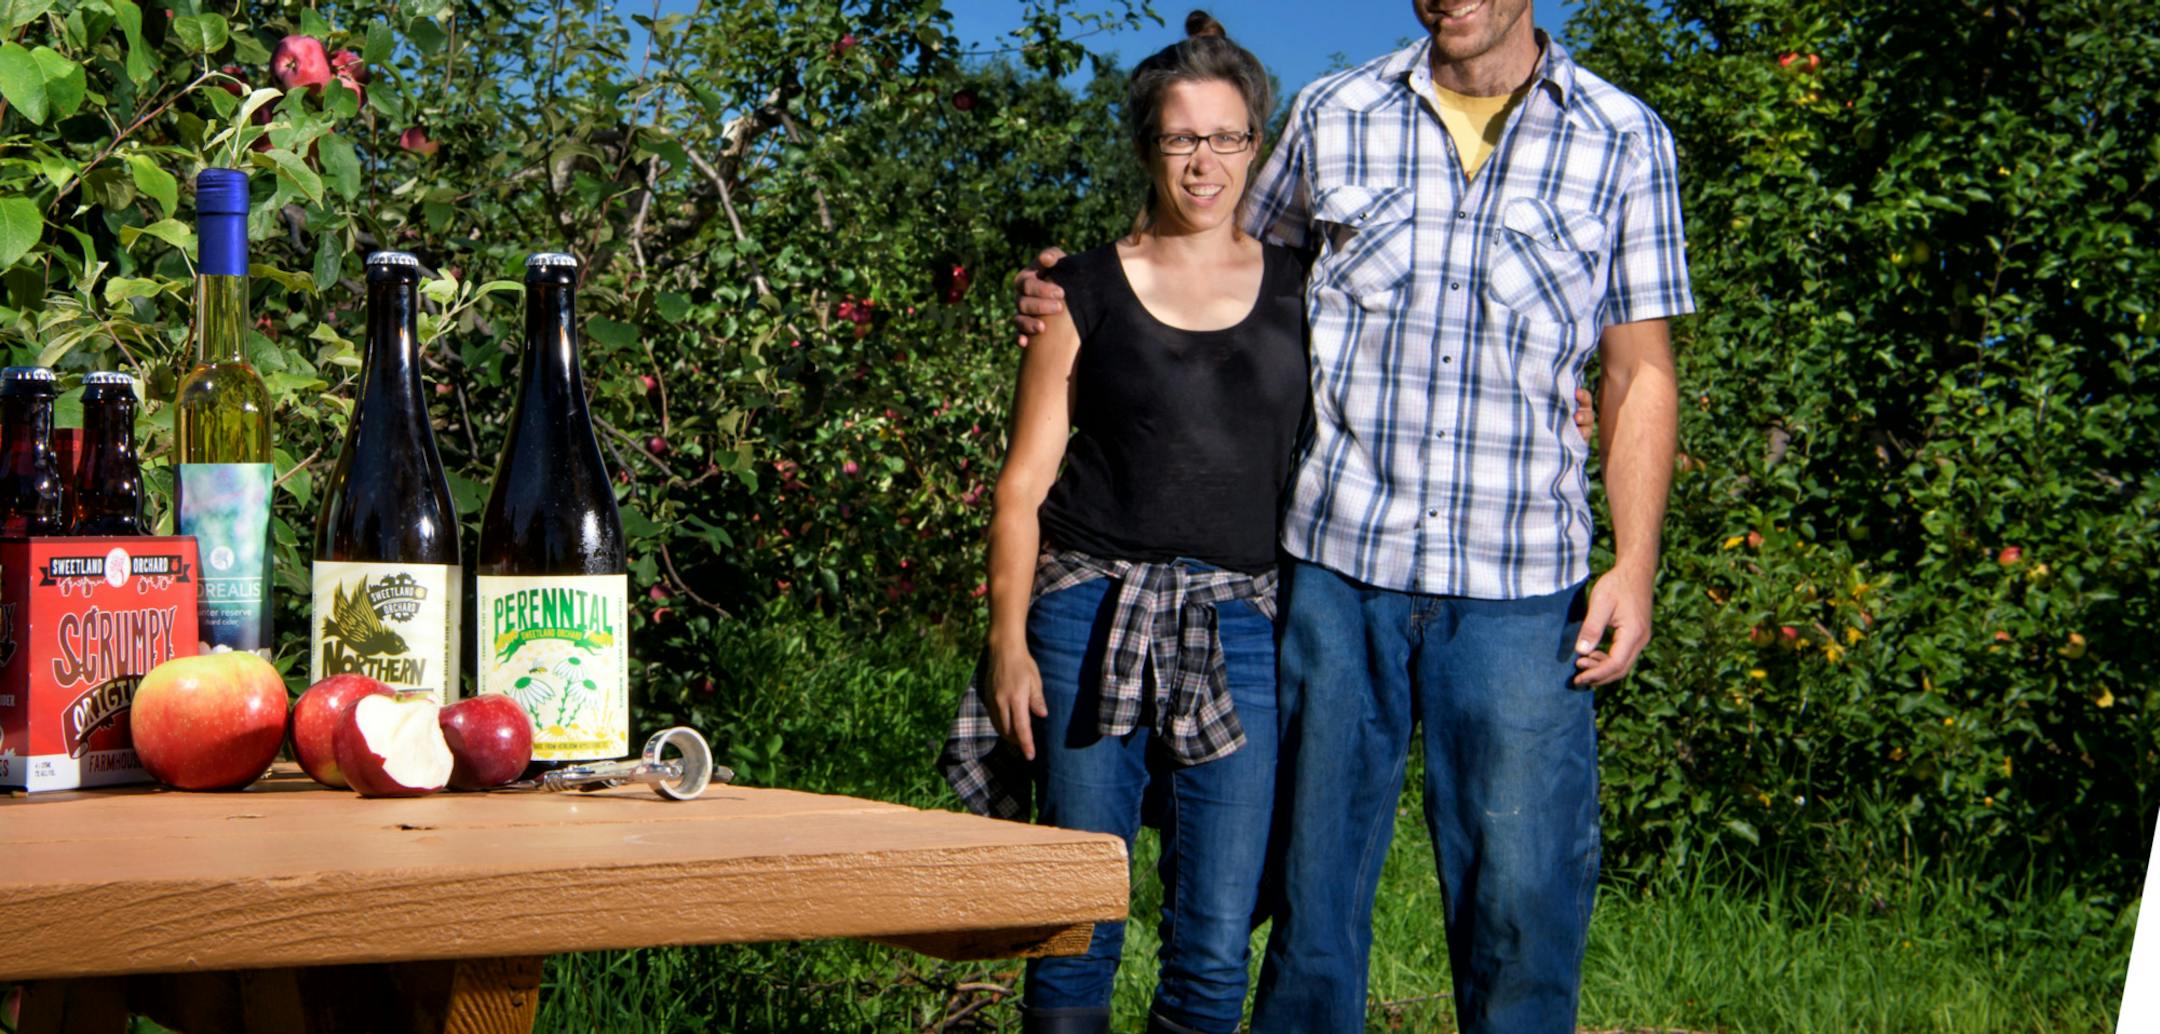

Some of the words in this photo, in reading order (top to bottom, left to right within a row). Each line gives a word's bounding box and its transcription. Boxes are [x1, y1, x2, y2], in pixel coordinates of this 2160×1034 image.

[52, 557, 103, 575] SWEETLAND
[132, 557, 169, 574] ORCHARD
[370, 586, 415, 603] SWEETLAND
[382, 601, 417, 615] ORCHARD
[494, 587, 614, 644] PERENNIAL
[52, 605, 178, 688] SCRUMPY
[321, 639, 426, 686] NORTHERN
